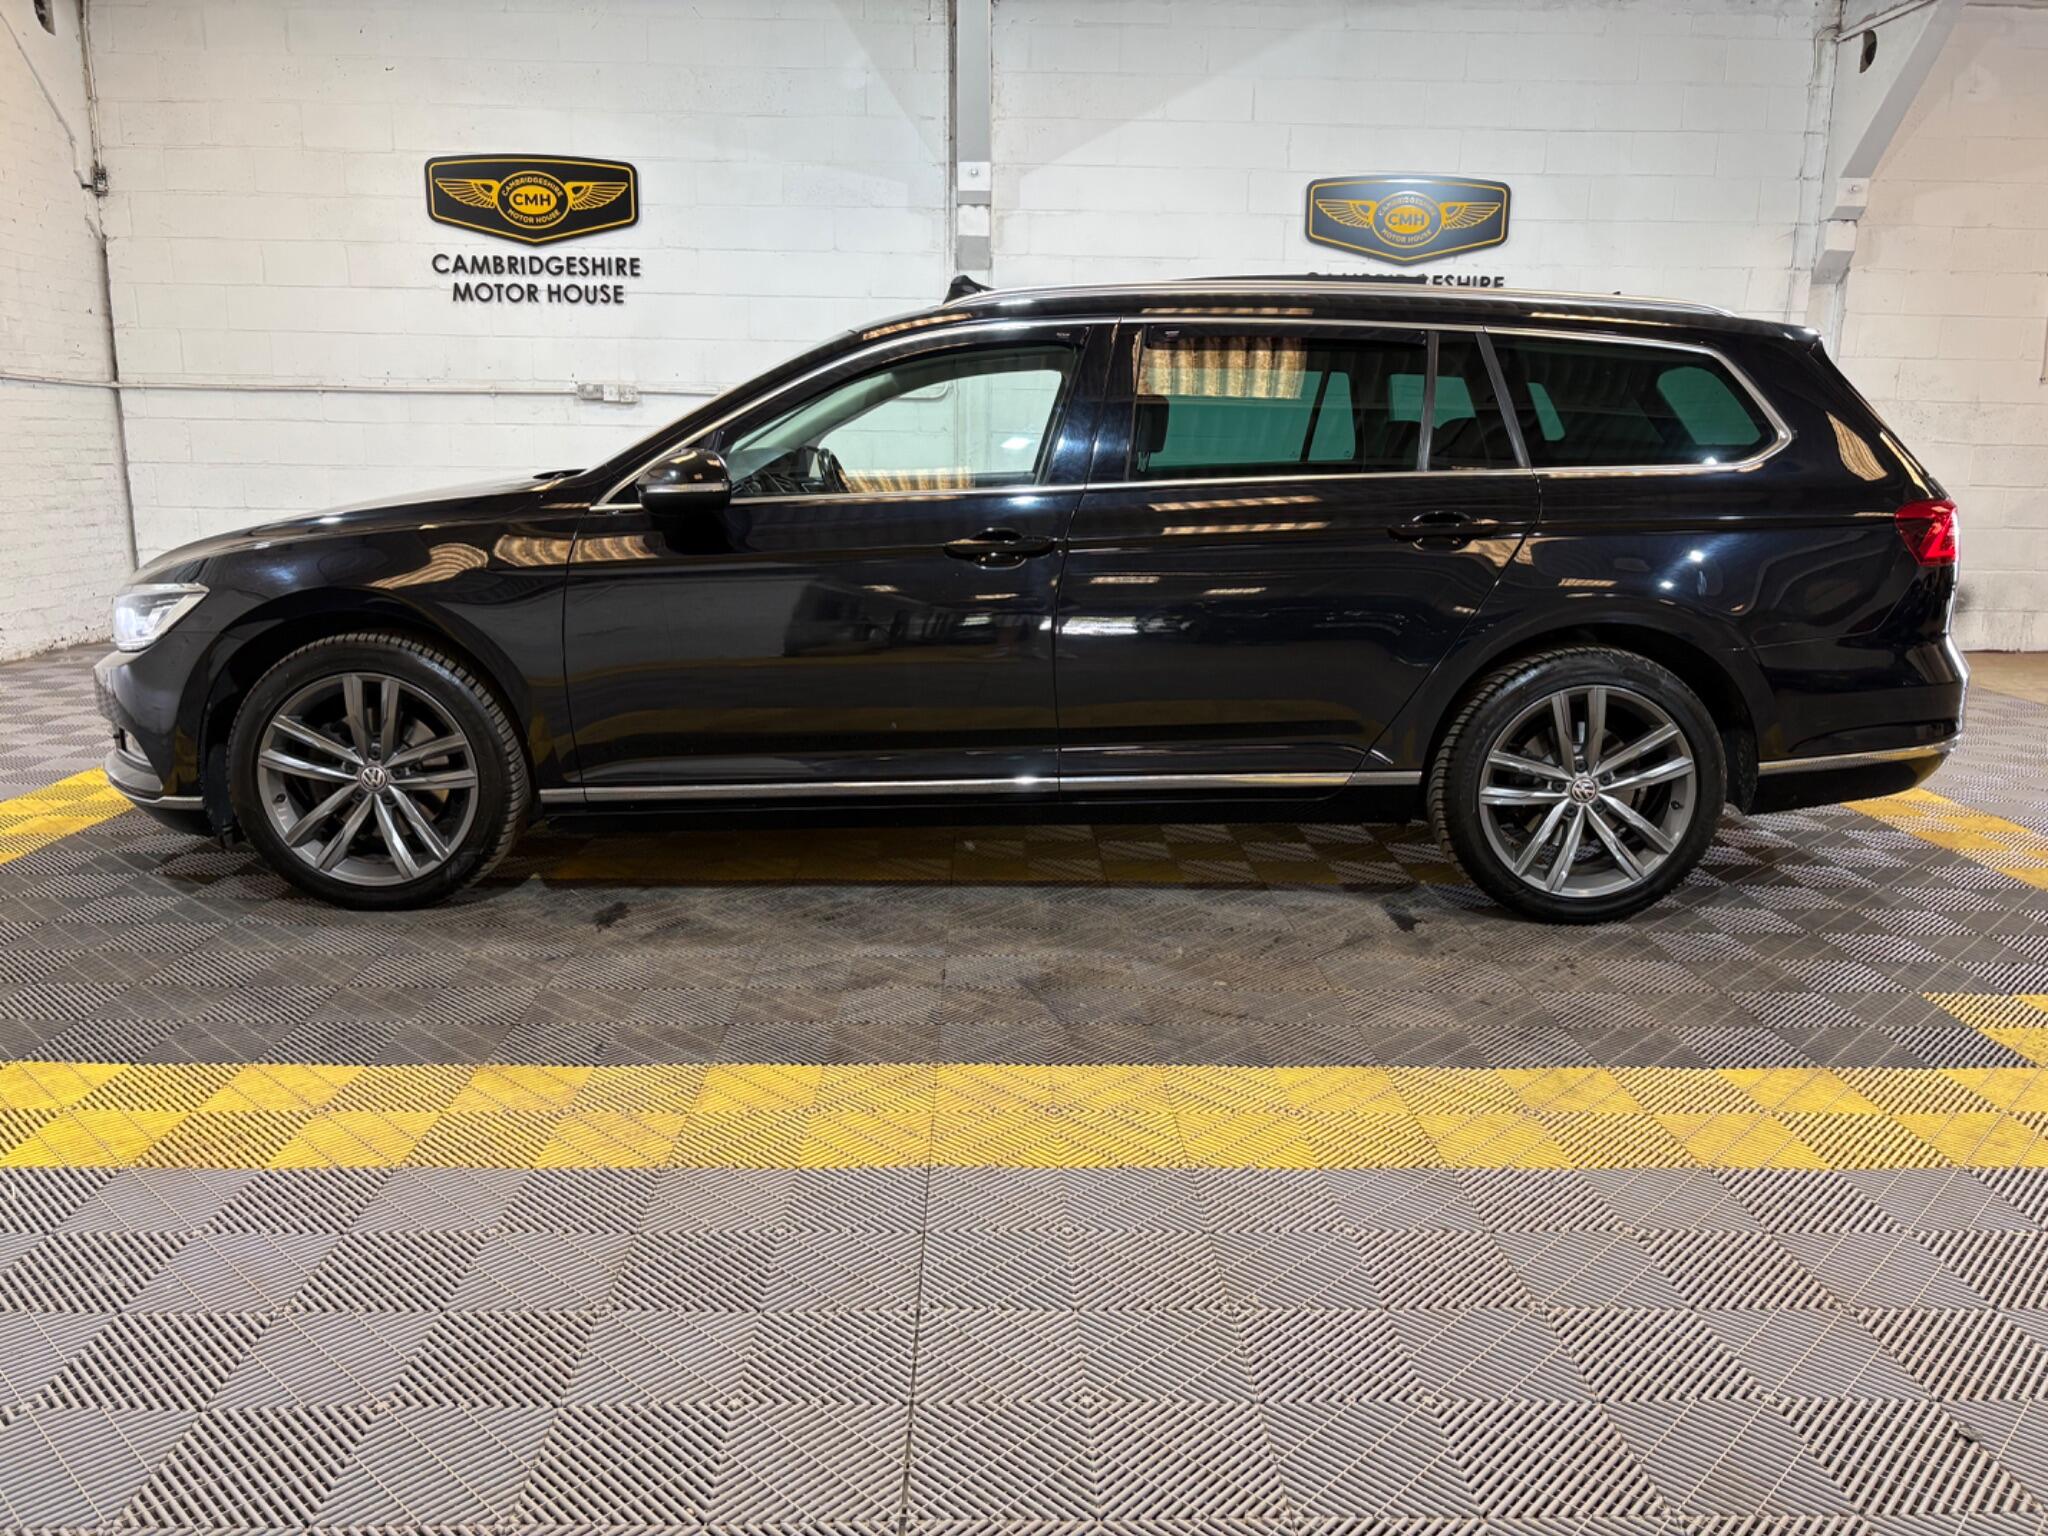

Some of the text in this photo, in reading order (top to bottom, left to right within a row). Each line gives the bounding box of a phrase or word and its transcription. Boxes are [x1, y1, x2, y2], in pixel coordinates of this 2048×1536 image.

[502, 176, 564, 198] CAMBRIDGESHIRE
[512, 193, 551, 206] CMH
[507, 208, 561, 224] MOTOR HOUSE
[1388, 213, 1425, 227] CMH
[1381, 228, 1432, 243] MOTOR HOUSE
[432, 253, 641, 277] CAMBRIDGESHIRE
[452, 282, 625, 305] MOTOR HOUSE
